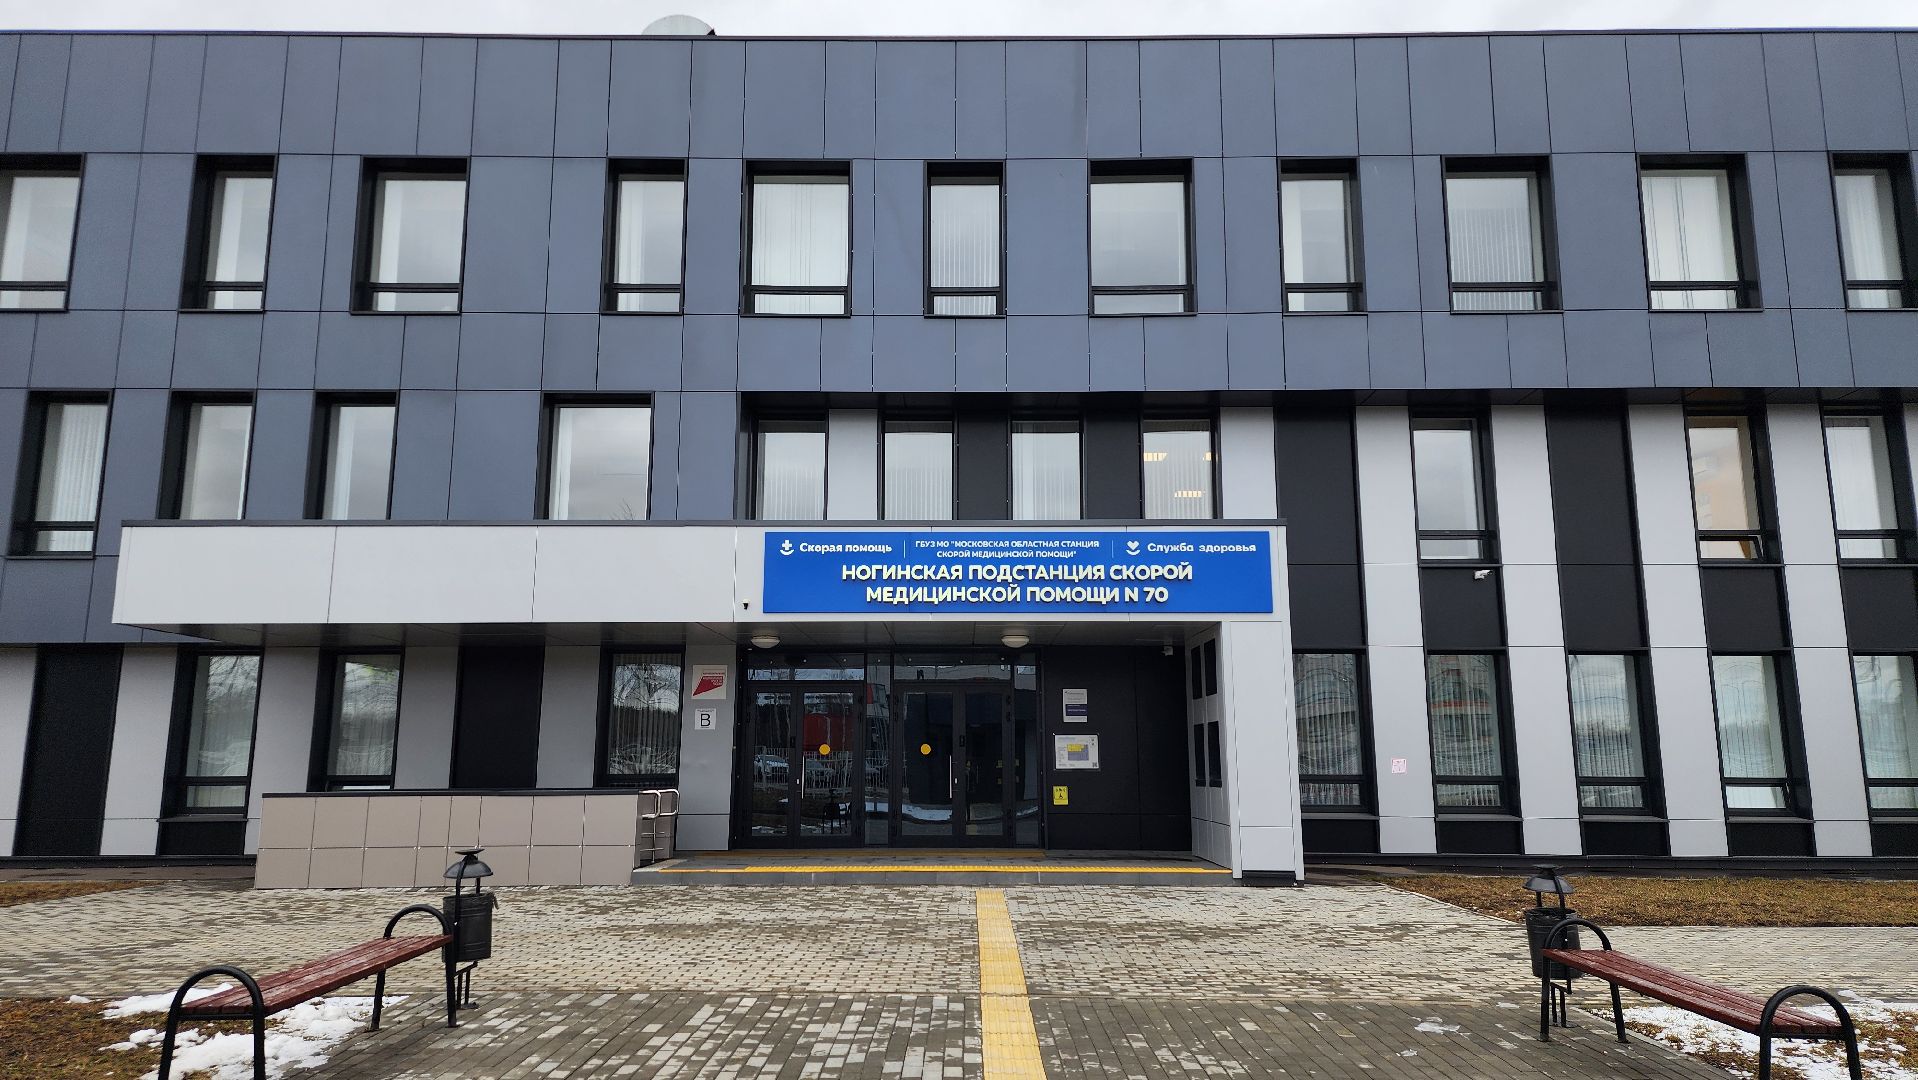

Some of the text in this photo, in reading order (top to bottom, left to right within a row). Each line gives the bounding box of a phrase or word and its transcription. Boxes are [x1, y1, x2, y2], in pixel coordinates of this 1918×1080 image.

[799, 542, 893, 554] Скорая помощь
[915, 540, 935, 548] ГБУЗ
[936, 540, 950, 548] МО
[1010, 540, 1060, 548] ОБЛАСТНАЯ
[1060, 540, 1100, 549] СТАНЦИЯ
[1147, 542, 1257, 554] Служба здоровья
[936, 549, 971, 558] СКОРОЙ
[971, 549, 1034, 559] МЕДИЦИНСКОЙ
[842, 561, 1193, 583] НОГИНСКАЯ ПОДСТАНЦИЯ СКОРОЙ
[866, 584, 1169, 605] МЕДИЦИНСКОЙ ПОМОЩИ N 70
